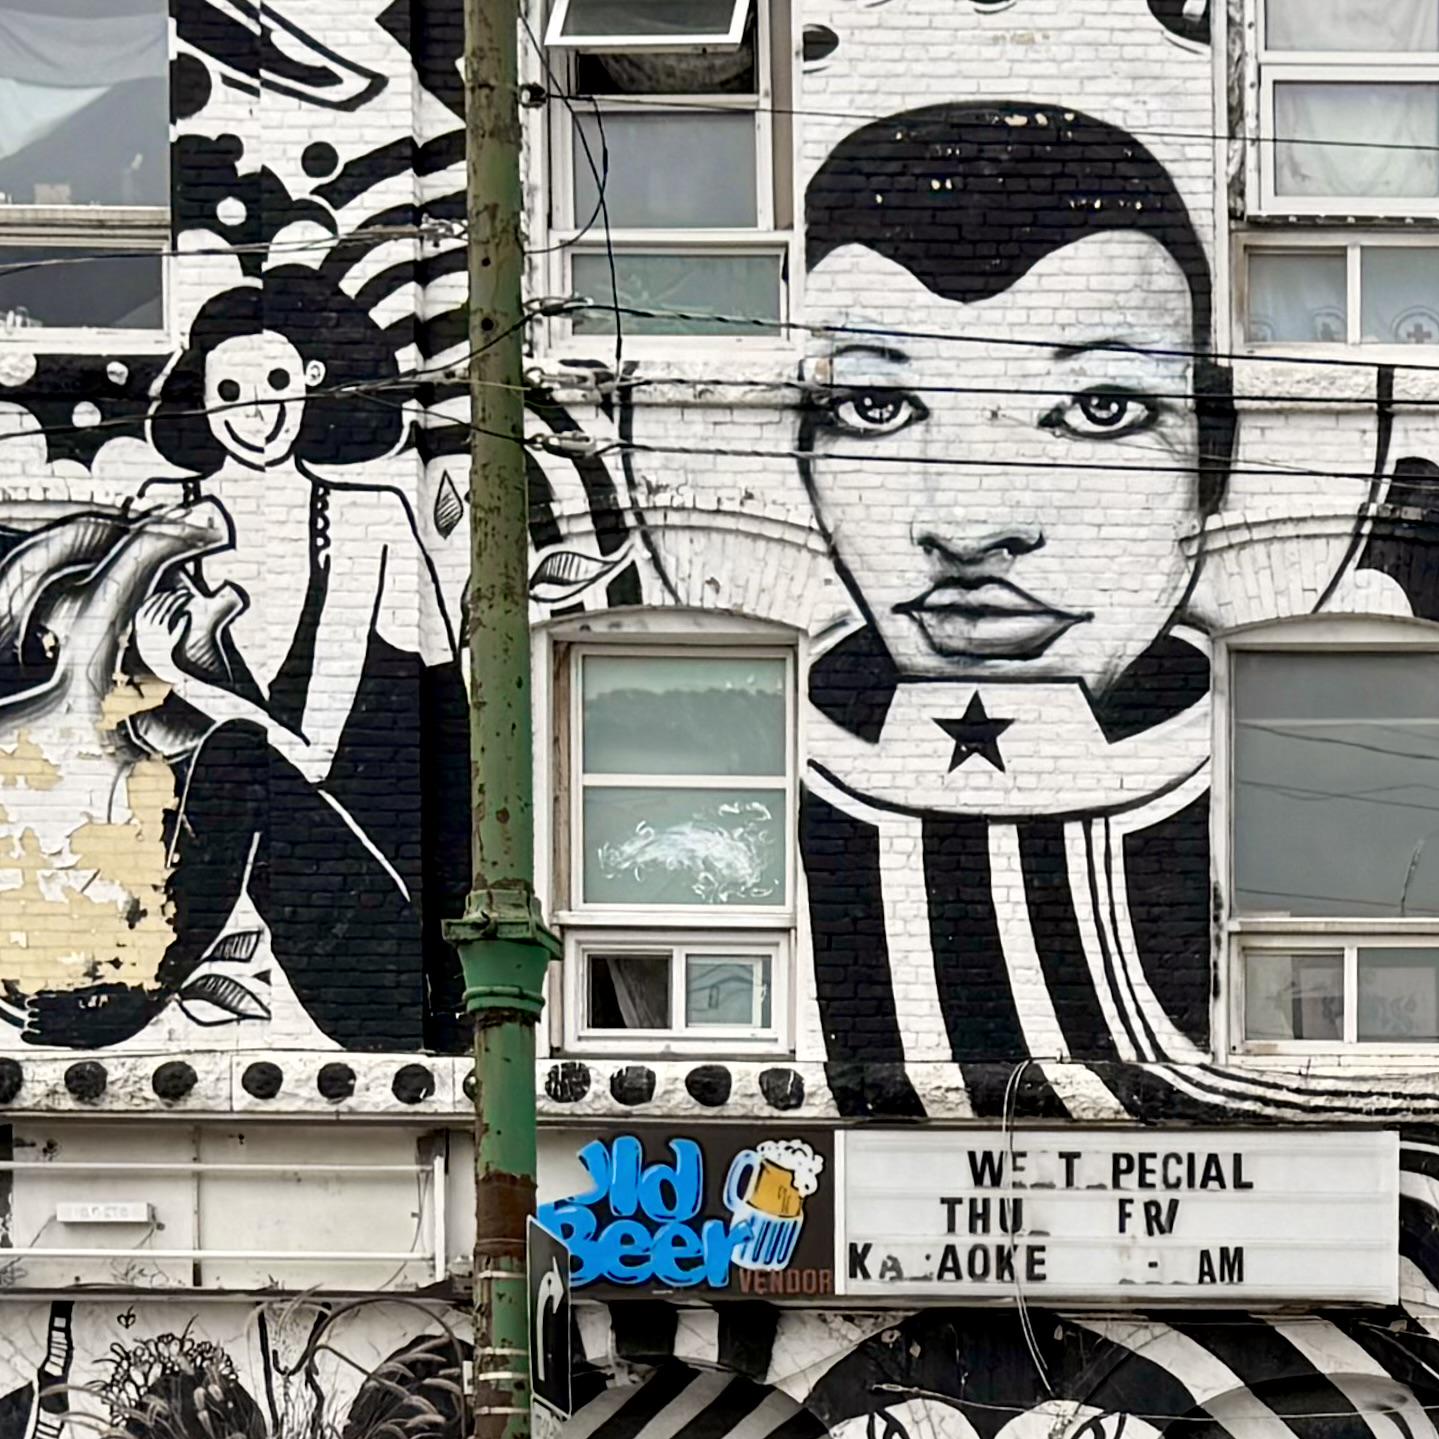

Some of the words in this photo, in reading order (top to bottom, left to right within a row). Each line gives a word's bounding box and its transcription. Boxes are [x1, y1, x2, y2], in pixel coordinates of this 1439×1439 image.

[538, 1203, 755, 1288] Beer
[738, 1268, 832, 1294] VENDOR
[1198, 1246, 1244, 1285] AM
